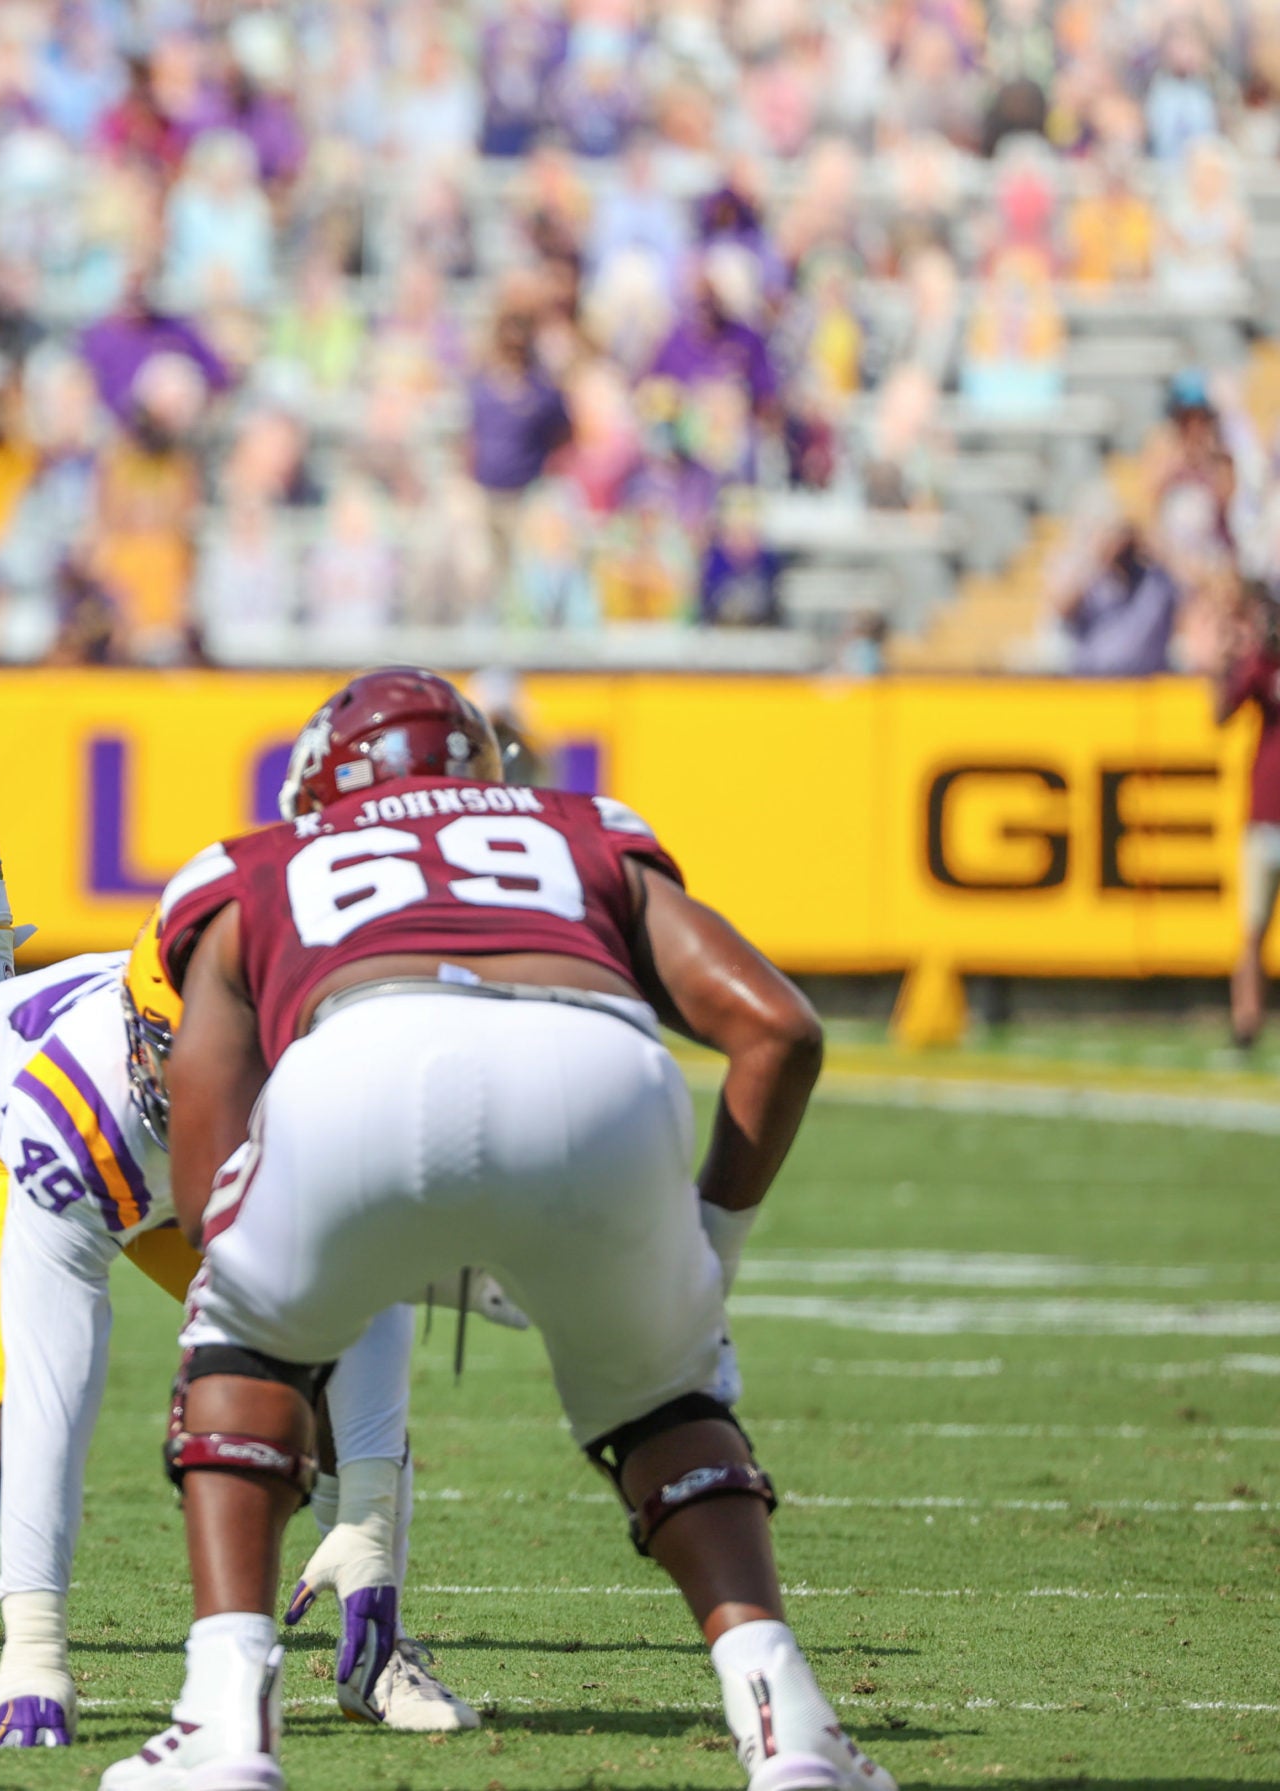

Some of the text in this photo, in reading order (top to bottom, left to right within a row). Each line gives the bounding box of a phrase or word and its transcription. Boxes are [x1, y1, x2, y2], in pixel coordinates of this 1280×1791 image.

[353, 786, 545, 827] JOHNSON
[925, 764, 1224, 894] GE
[285, 814, 586, 949] 69
[14, 1137, 87, 1214] 49
